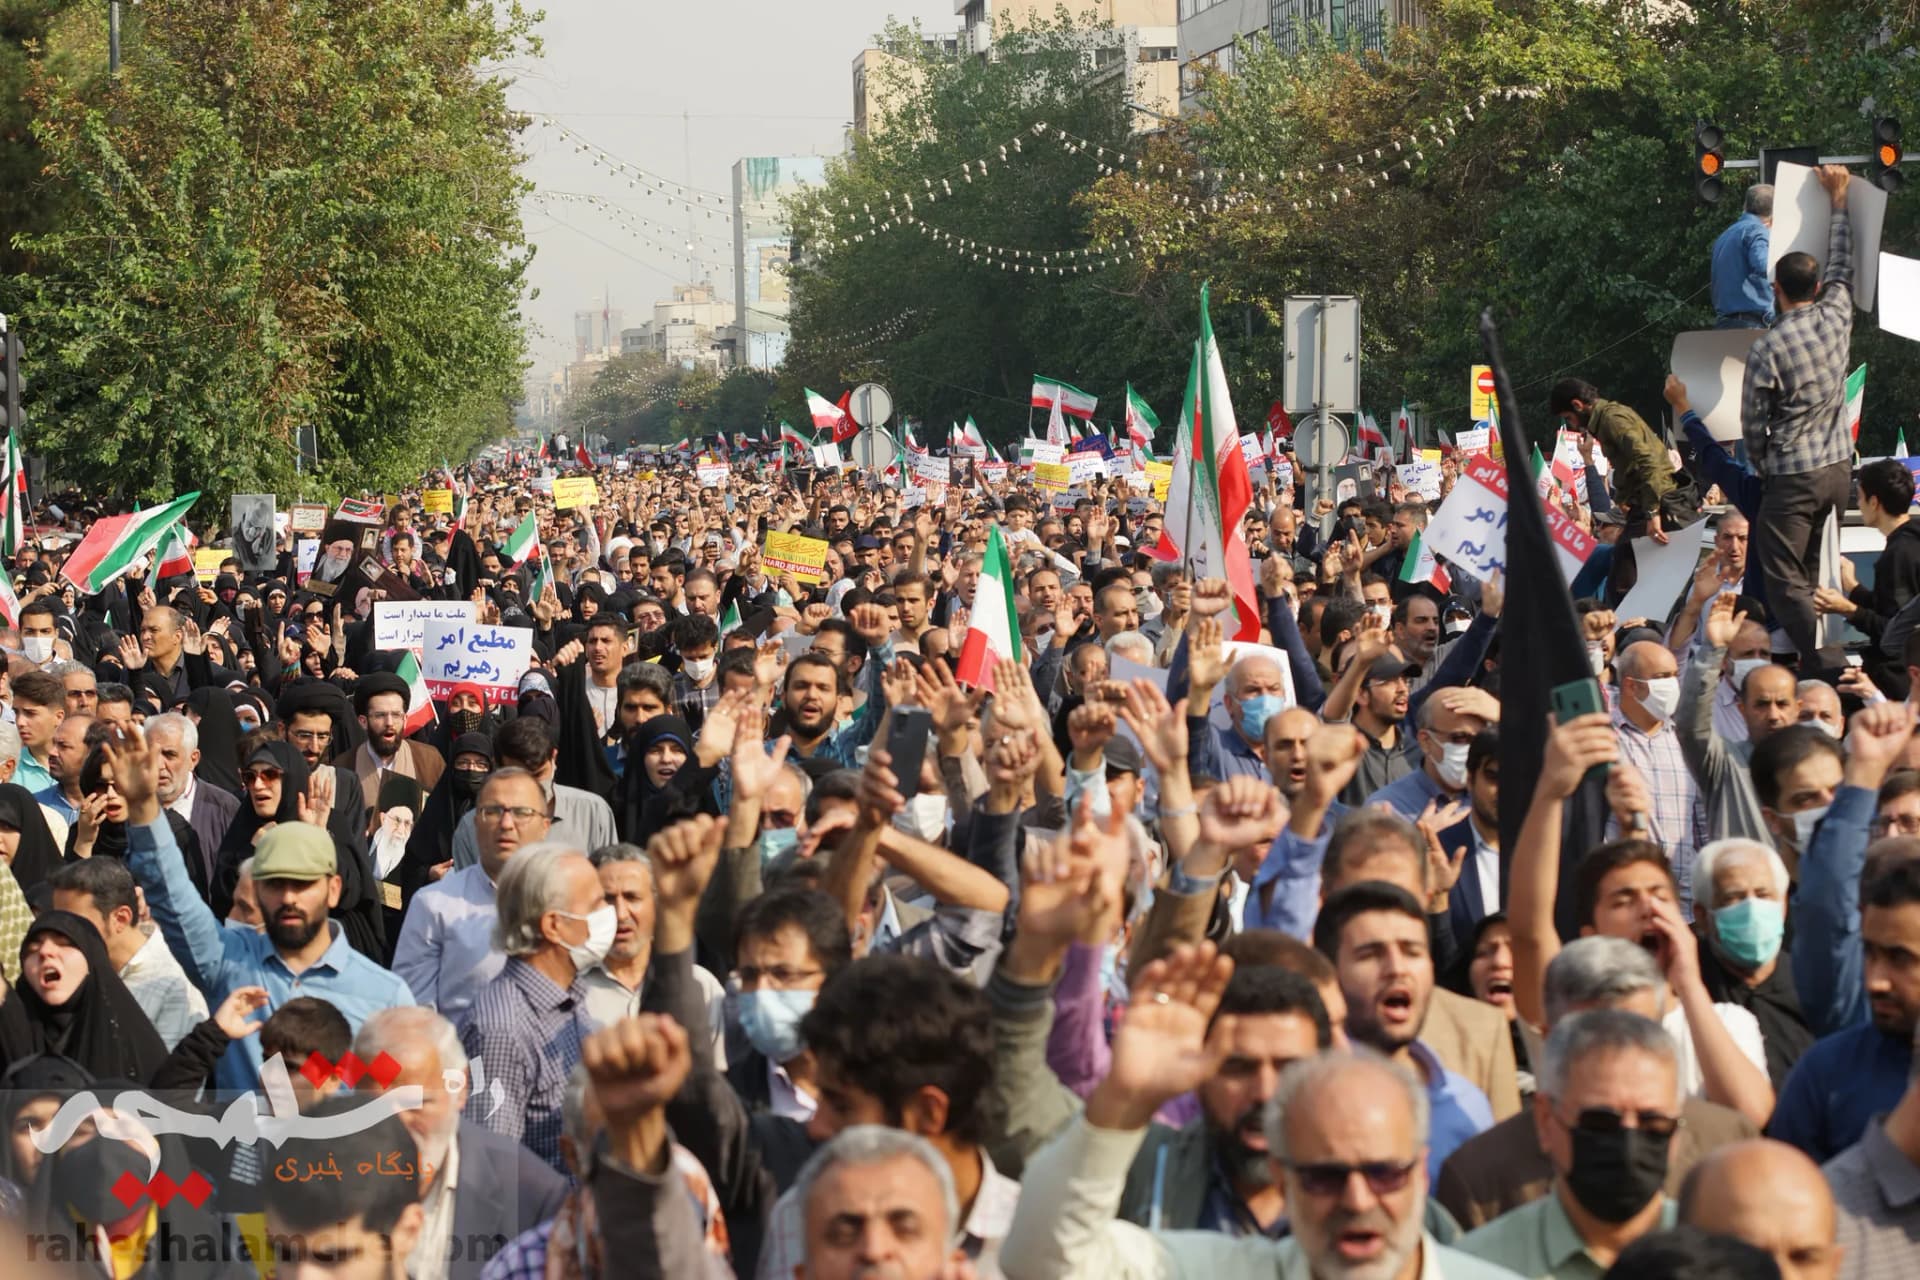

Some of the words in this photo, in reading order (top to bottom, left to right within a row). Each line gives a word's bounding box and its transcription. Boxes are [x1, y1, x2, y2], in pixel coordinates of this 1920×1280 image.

[765, 558, 786, 569] HARD
[786, 564, 821, 576] REVENGE
[383, 609, 405, 620] است
[408, 609, 432, 622] بیدار
[434, 607, 443, 619] ما
[446, 609, 466, 619] ملت
[377, 629, 399, 641] است
[436, 627, 464, 650] امر
[467, 629, 517, 653] مطیع
[444, 658, 500, 681] رهبریم
